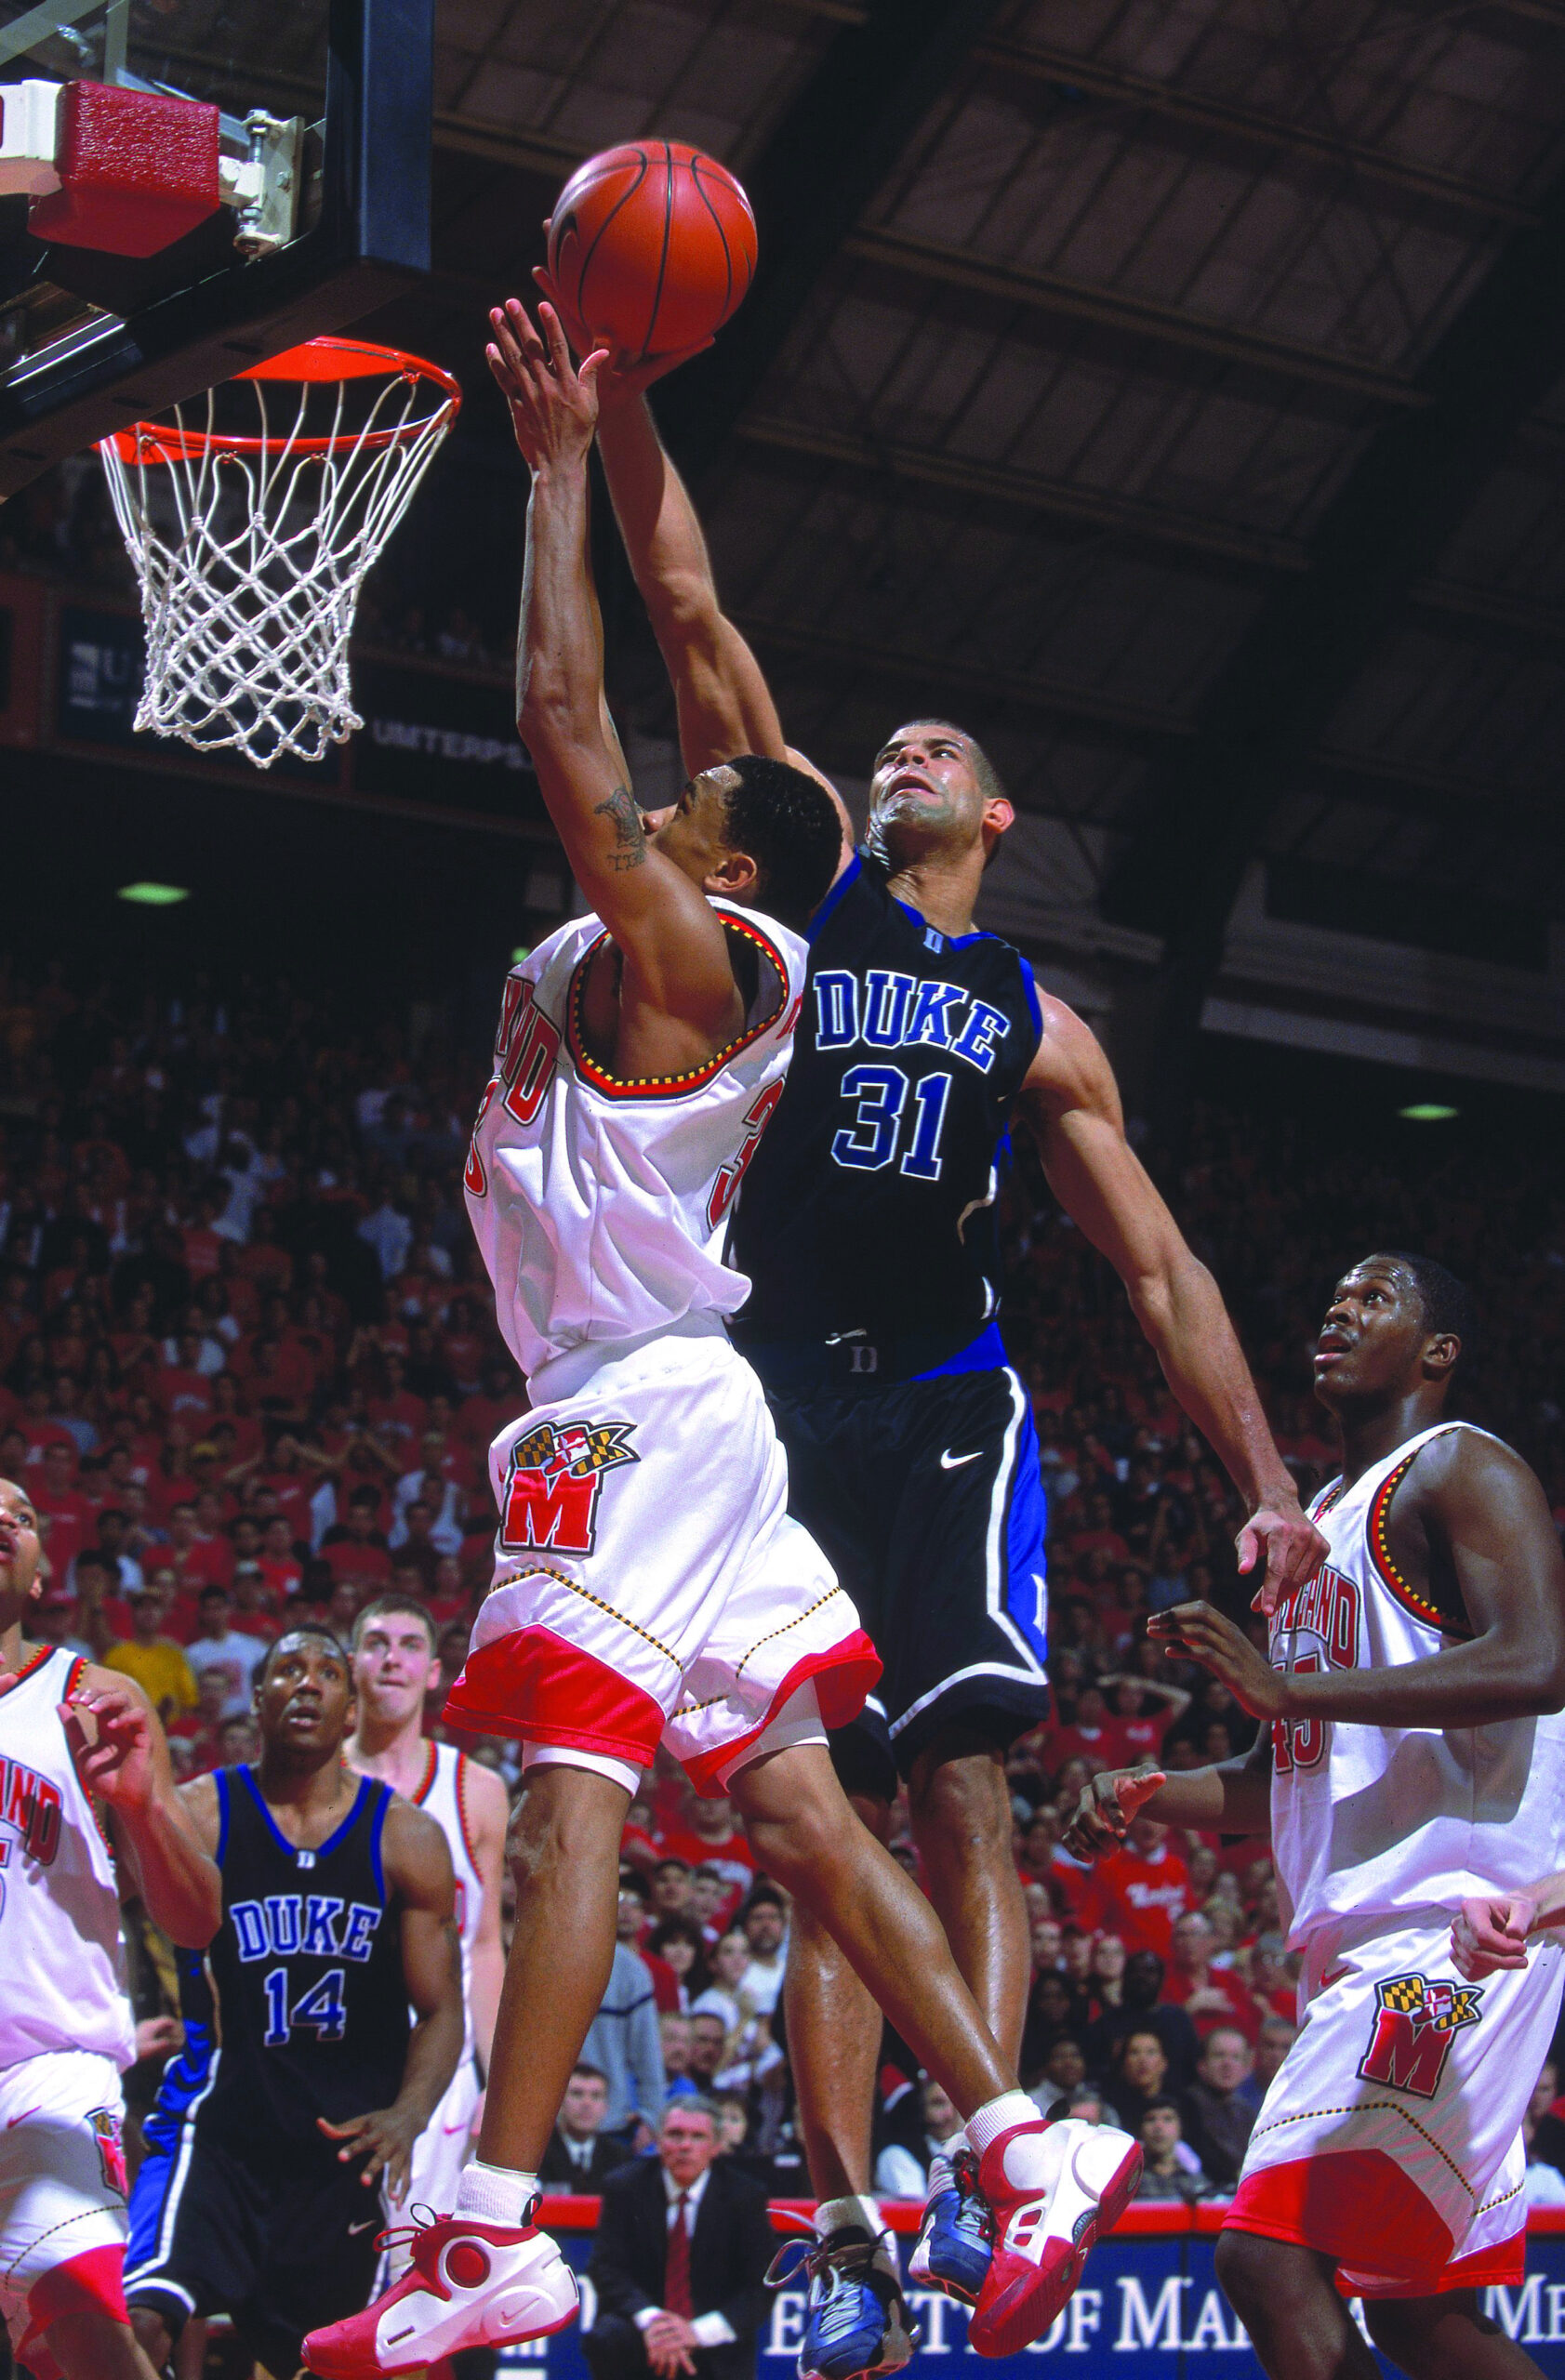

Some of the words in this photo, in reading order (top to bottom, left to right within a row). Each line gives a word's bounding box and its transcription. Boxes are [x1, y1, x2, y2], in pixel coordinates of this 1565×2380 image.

[813, 970, 1012, 1075] DUKE
[830, 1064, 952, 1181] 31
[500, 1466, 603, 1556] M
[230, 1894, 382, 1963] DUKE
[264, 1966, 346, 2046] 14
[1356, 2005, 1458, 2100] M
